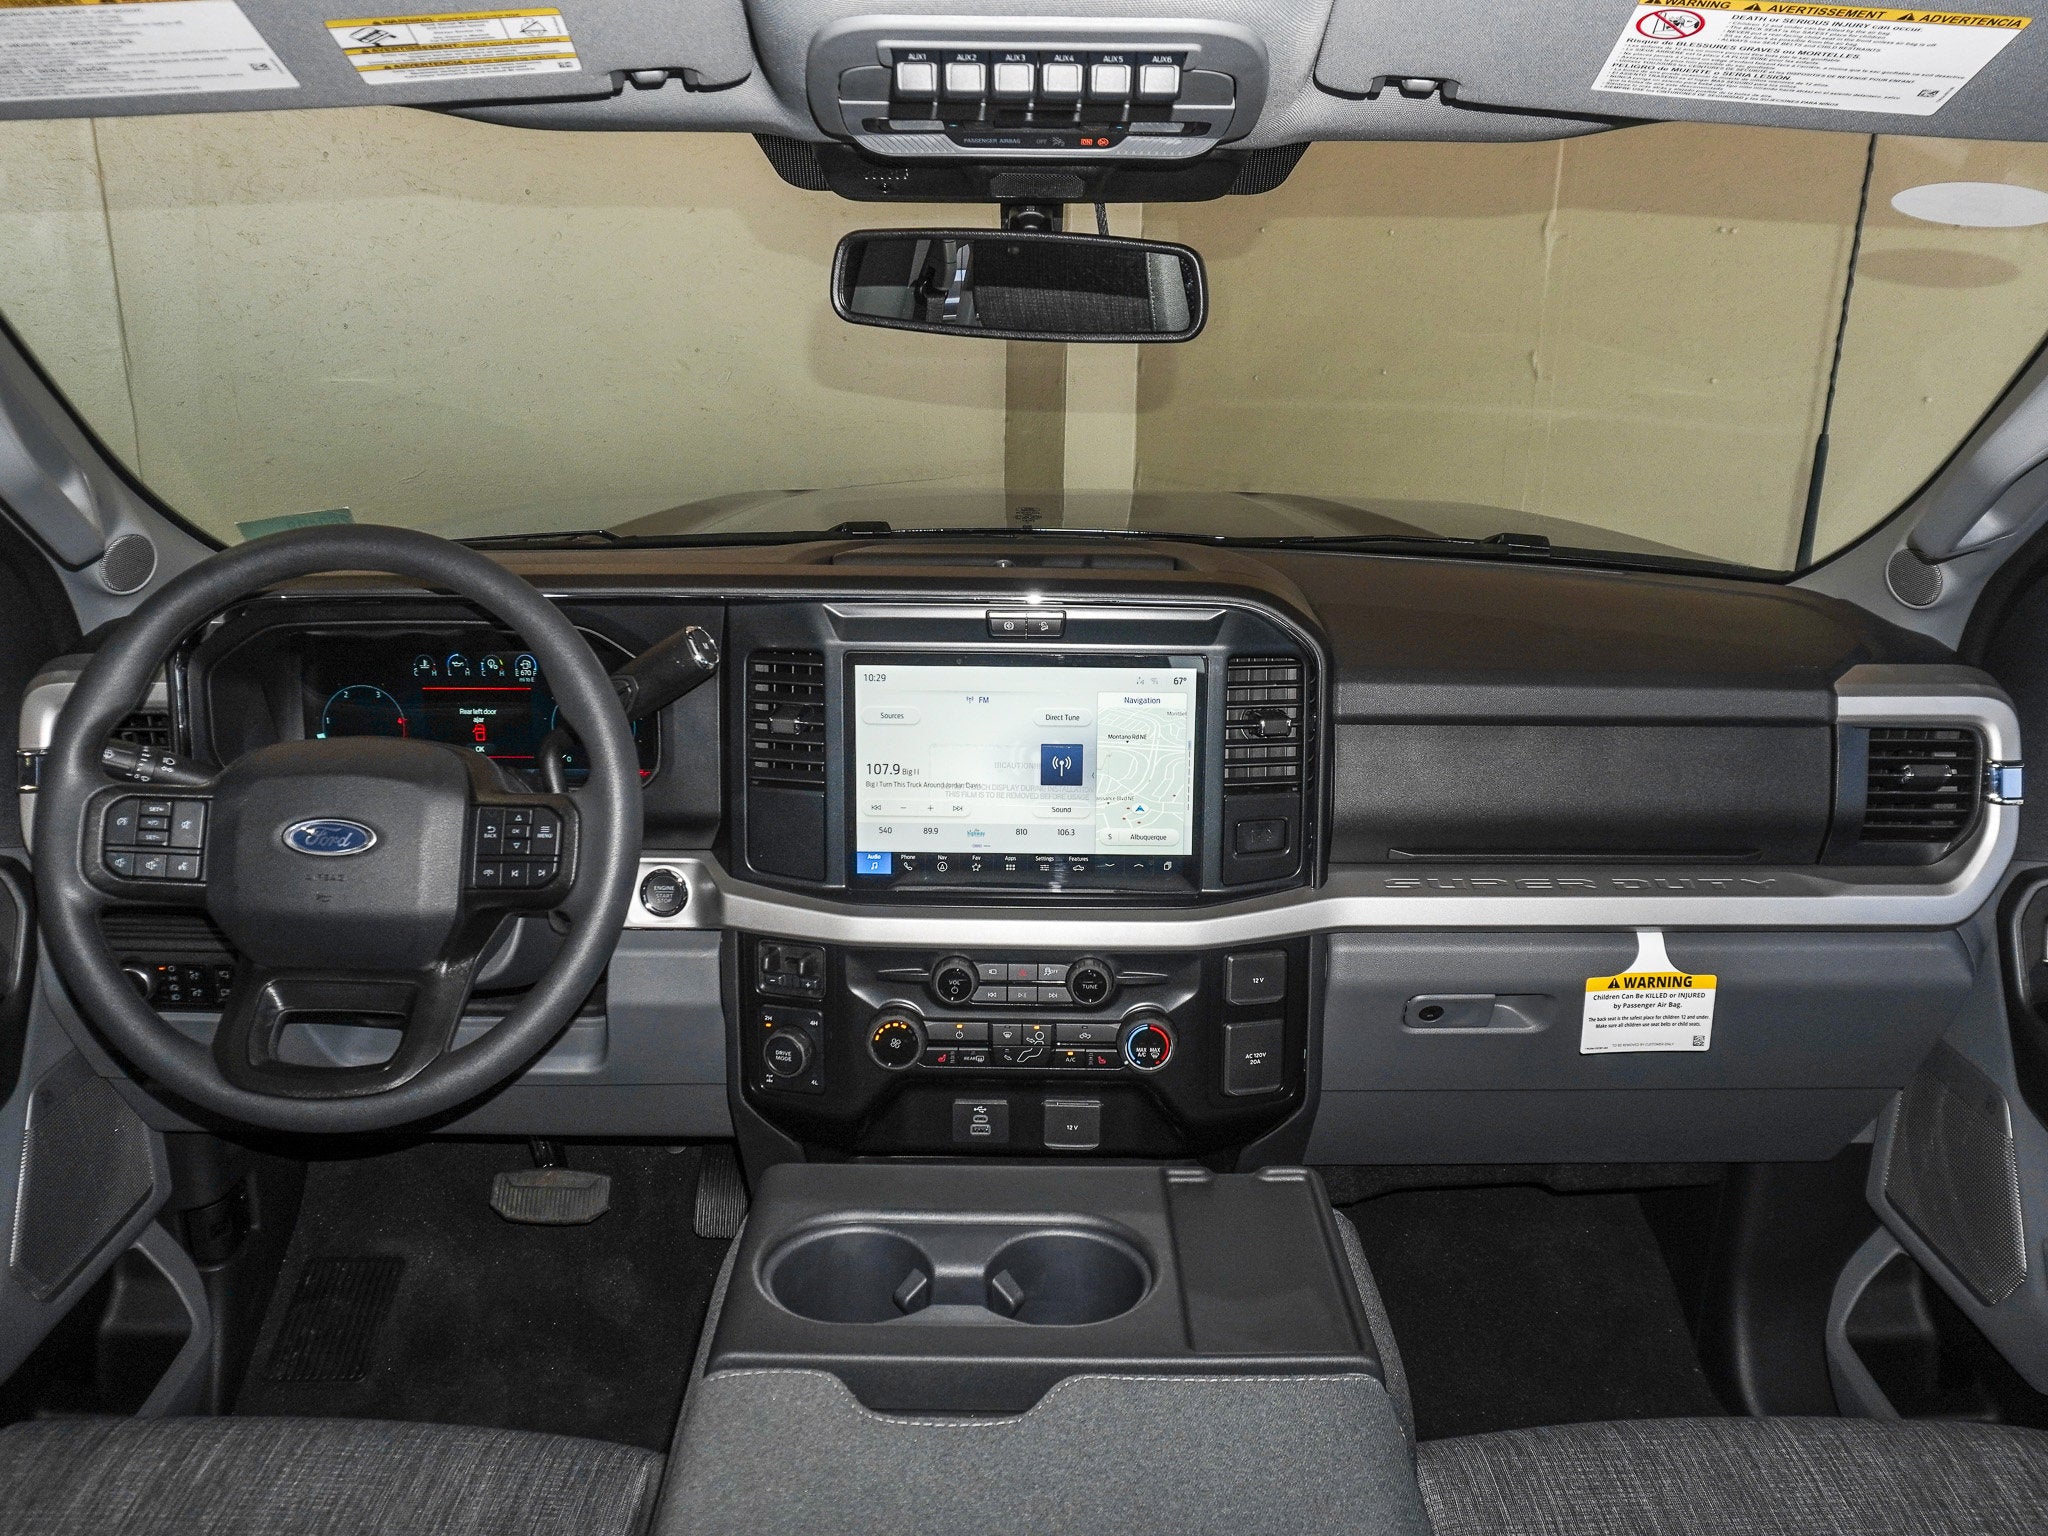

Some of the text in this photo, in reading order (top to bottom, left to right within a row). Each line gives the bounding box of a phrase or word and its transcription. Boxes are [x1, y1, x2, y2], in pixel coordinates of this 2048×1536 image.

[1665, 0, 2022, 27] WARNING AVERTISSEMENT ADVERTENCIA
[1676, 41, 1737, 50] BLESSURES
[866, 763, 900, 775] 107.9
[305, 826, 353, 847] Ford
[1384, 878, 1777, 889] SUPER DUTY
[1624, 976, 1693, 989] WARNING
